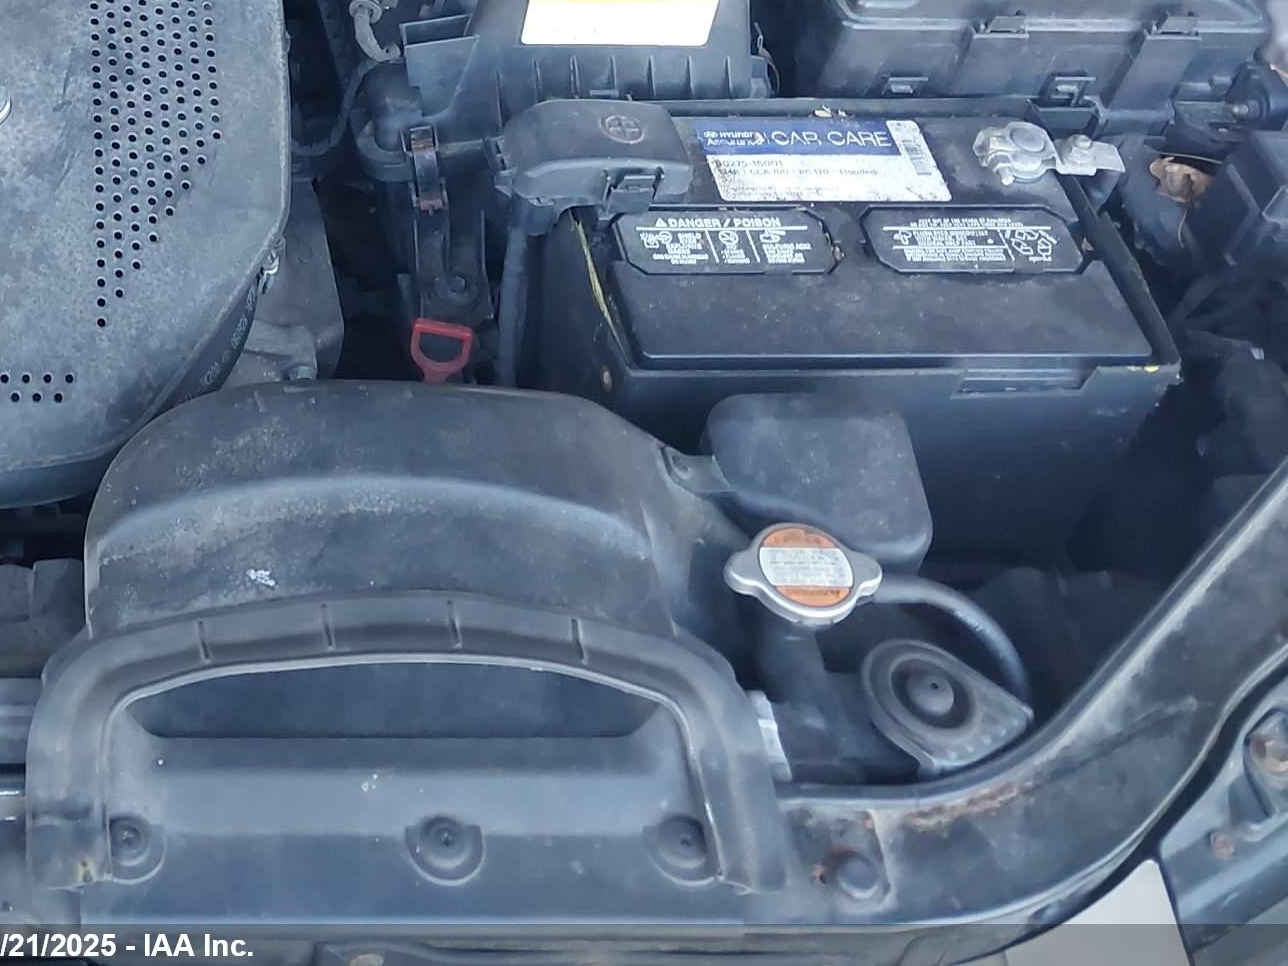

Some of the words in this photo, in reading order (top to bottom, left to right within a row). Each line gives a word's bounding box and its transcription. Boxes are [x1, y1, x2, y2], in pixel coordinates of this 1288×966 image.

[771, 130, 821, 146] CAR
[827, 130, 892, 147] CARE
[668, 218, 721, 228] DANGER
[733, 217, 782, 227] POISON
